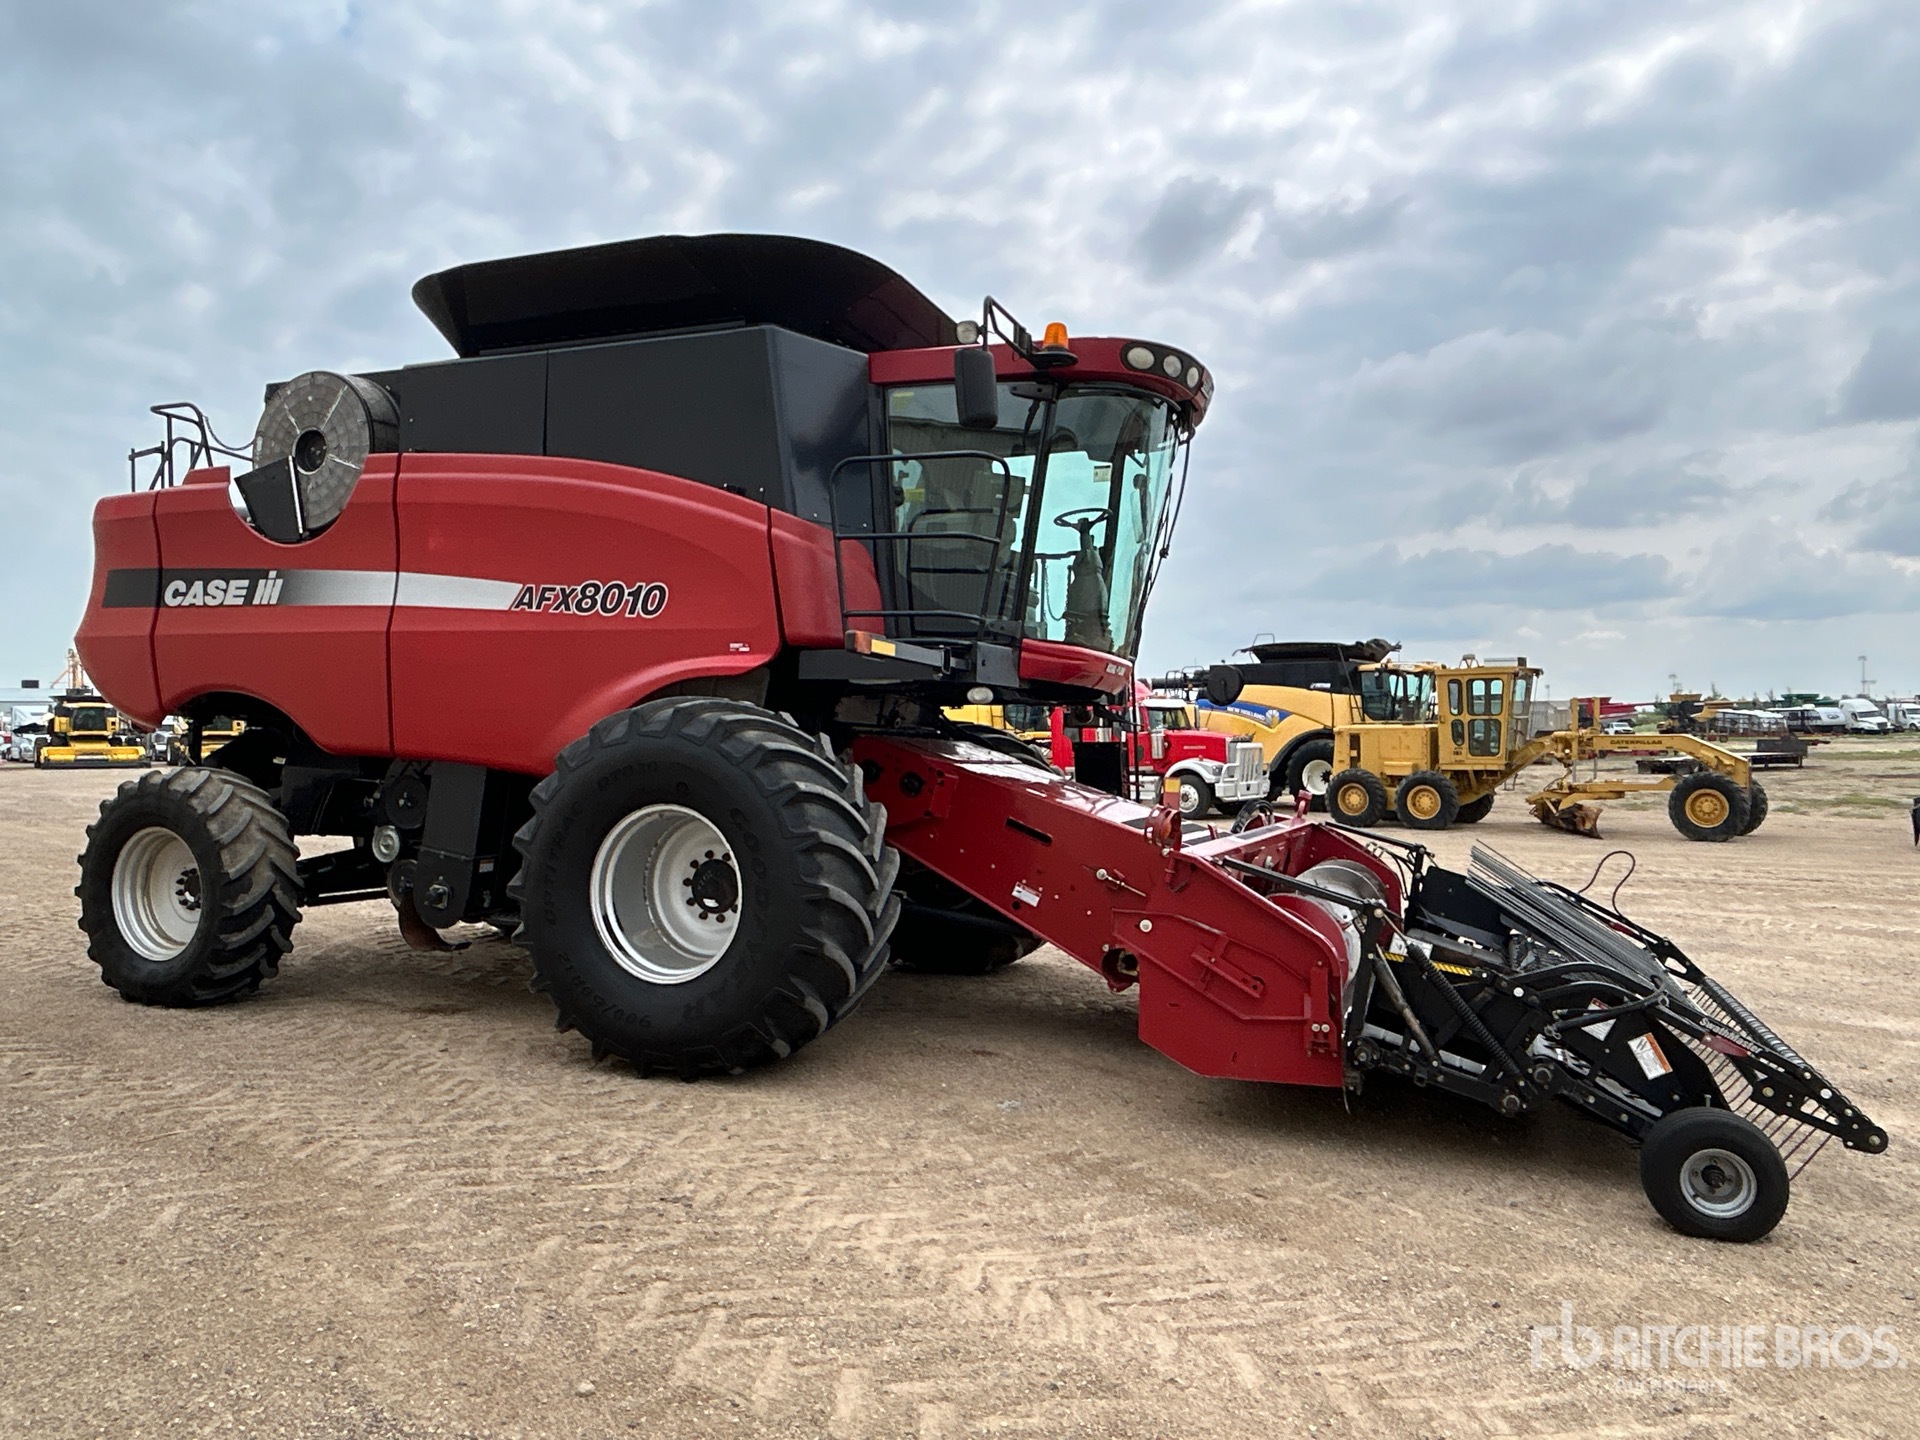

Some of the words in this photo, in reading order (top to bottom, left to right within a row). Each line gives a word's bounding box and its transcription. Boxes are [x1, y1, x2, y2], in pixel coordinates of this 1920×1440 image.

[163, 579, 249, 606] CASE
[511, 579, 669, 619] AFX8010
[1241, 708, 1266, 721] HOLLAND
[1699, 1017, 1764, 1055] SwathMaster
